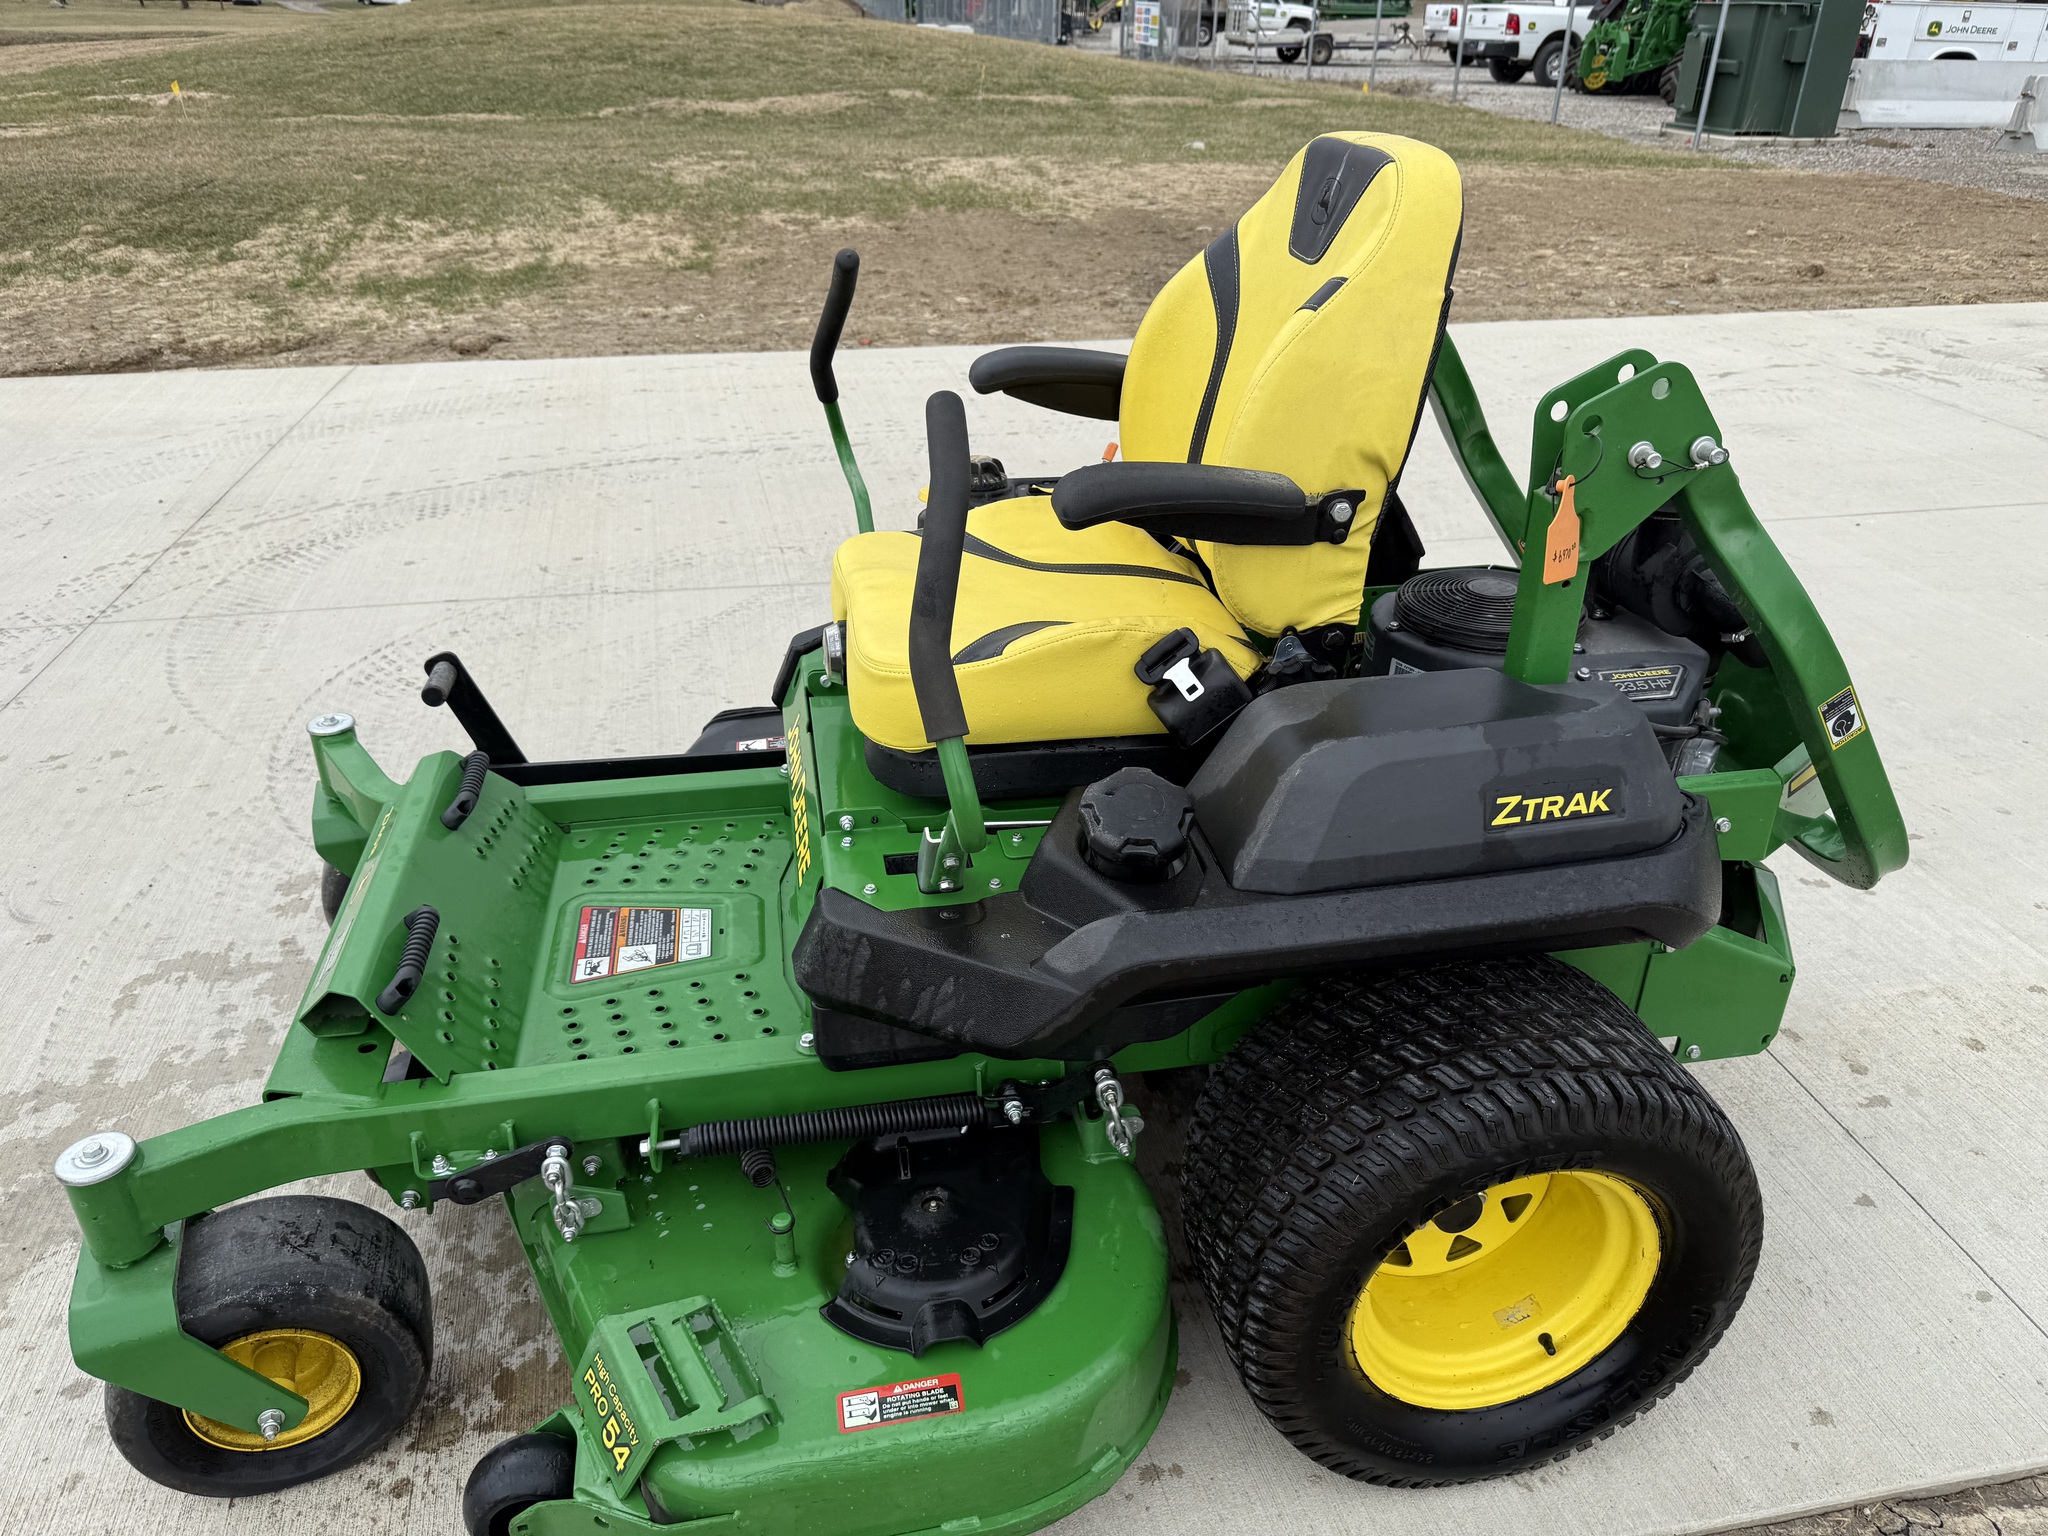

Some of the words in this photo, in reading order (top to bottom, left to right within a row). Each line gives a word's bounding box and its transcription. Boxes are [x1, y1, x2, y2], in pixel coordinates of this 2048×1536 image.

[1945, 24, 1969, 34] JOHN
[1969, 25, 1999, 35] DEERE
[1611, 672, 1638, 680] JOHN
[1636, 668, 1672, 678] DEERE
[1614, 680, 1649, 692] 23.5
[1649, 678, 1672, 689] HP
[1834, 730, 1860, 748] CAUTION
[787, 712, 804, 792] JOHN
[1490, 788, 1613, 826] ZTRAK
[792, 770, 811, 888] DEERE
[902, 1379, 939, 1391] DANGER
[593, 1352, 611, 1386] High
[608, 1383, 640, 1446] Capacity
[886, 1392, 920, 1403] ROTATING
[921, 1387, 945, 1397] BLADE
[901, 1399, 912, 1407] put
[912, 1396, 930, 1405] hands
[882, 1406, 900, 1415] under
[919, 1400, 938, 1408] mower
[883, 1411, 902, 1419] engine
[909, 1407, 932, 1415] running
[583, 1366, 609, 1417] PRO
[602, 1414, 631, 1472] 54
